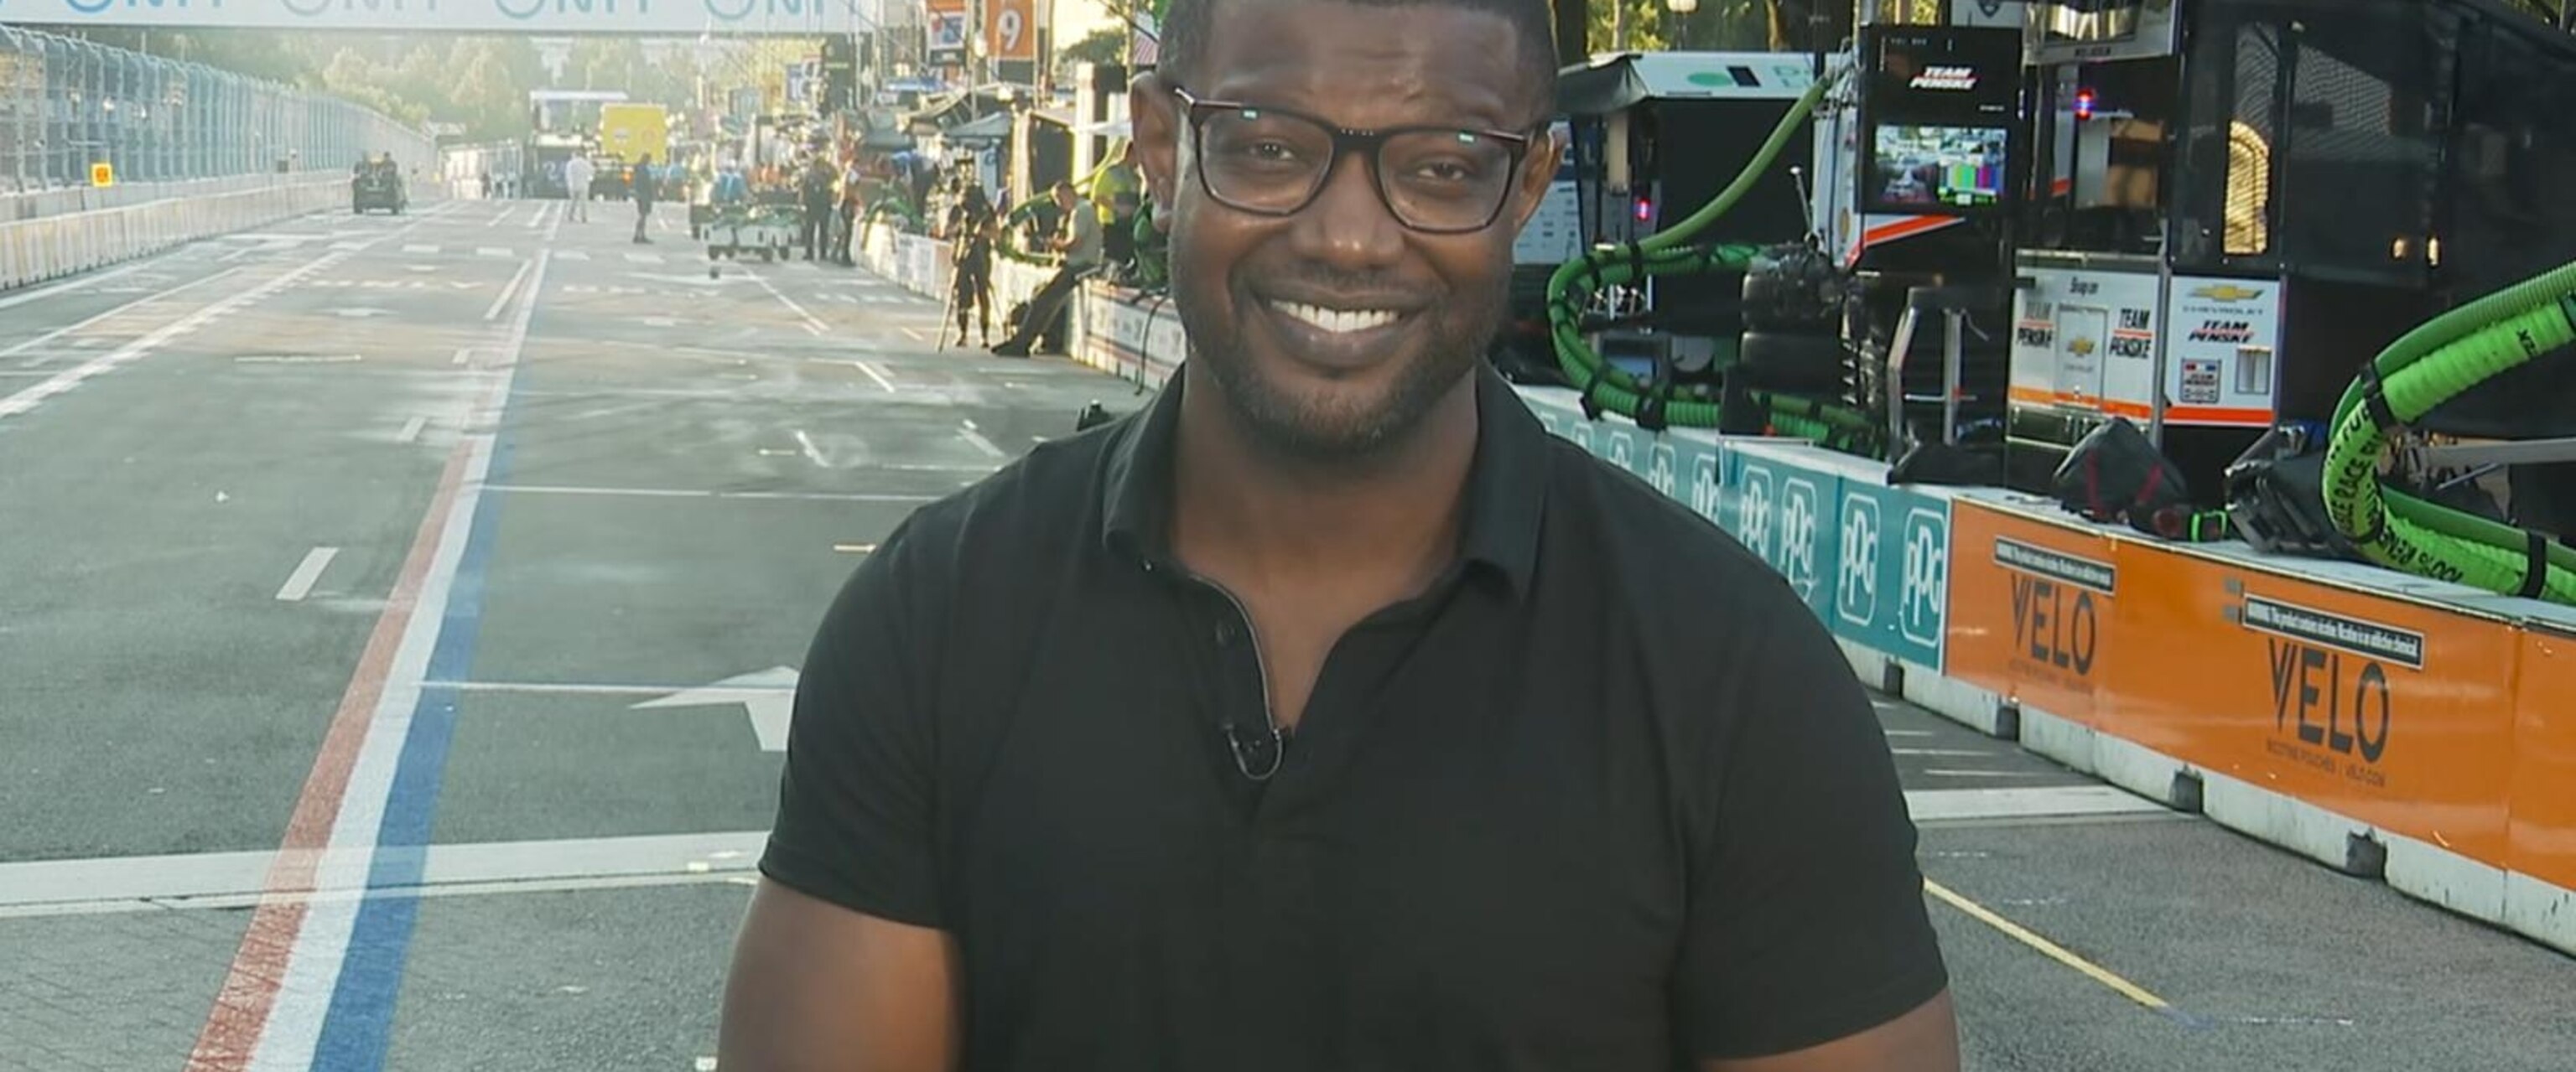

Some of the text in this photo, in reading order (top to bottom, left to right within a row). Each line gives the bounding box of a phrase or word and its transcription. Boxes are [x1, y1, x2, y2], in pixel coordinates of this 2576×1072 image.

[997, 9, 1021, 52] 9
[2119, 308, 2150, 329] TEAM
[2203, 320, 2249, 331] TEAM
[1841, 509, 1877, 607] PPG
[1903, 524, 1944, 627] PPG
[2011, 572, 2096, 676] VELO
[2268, 638, 2391, 764] VELO
